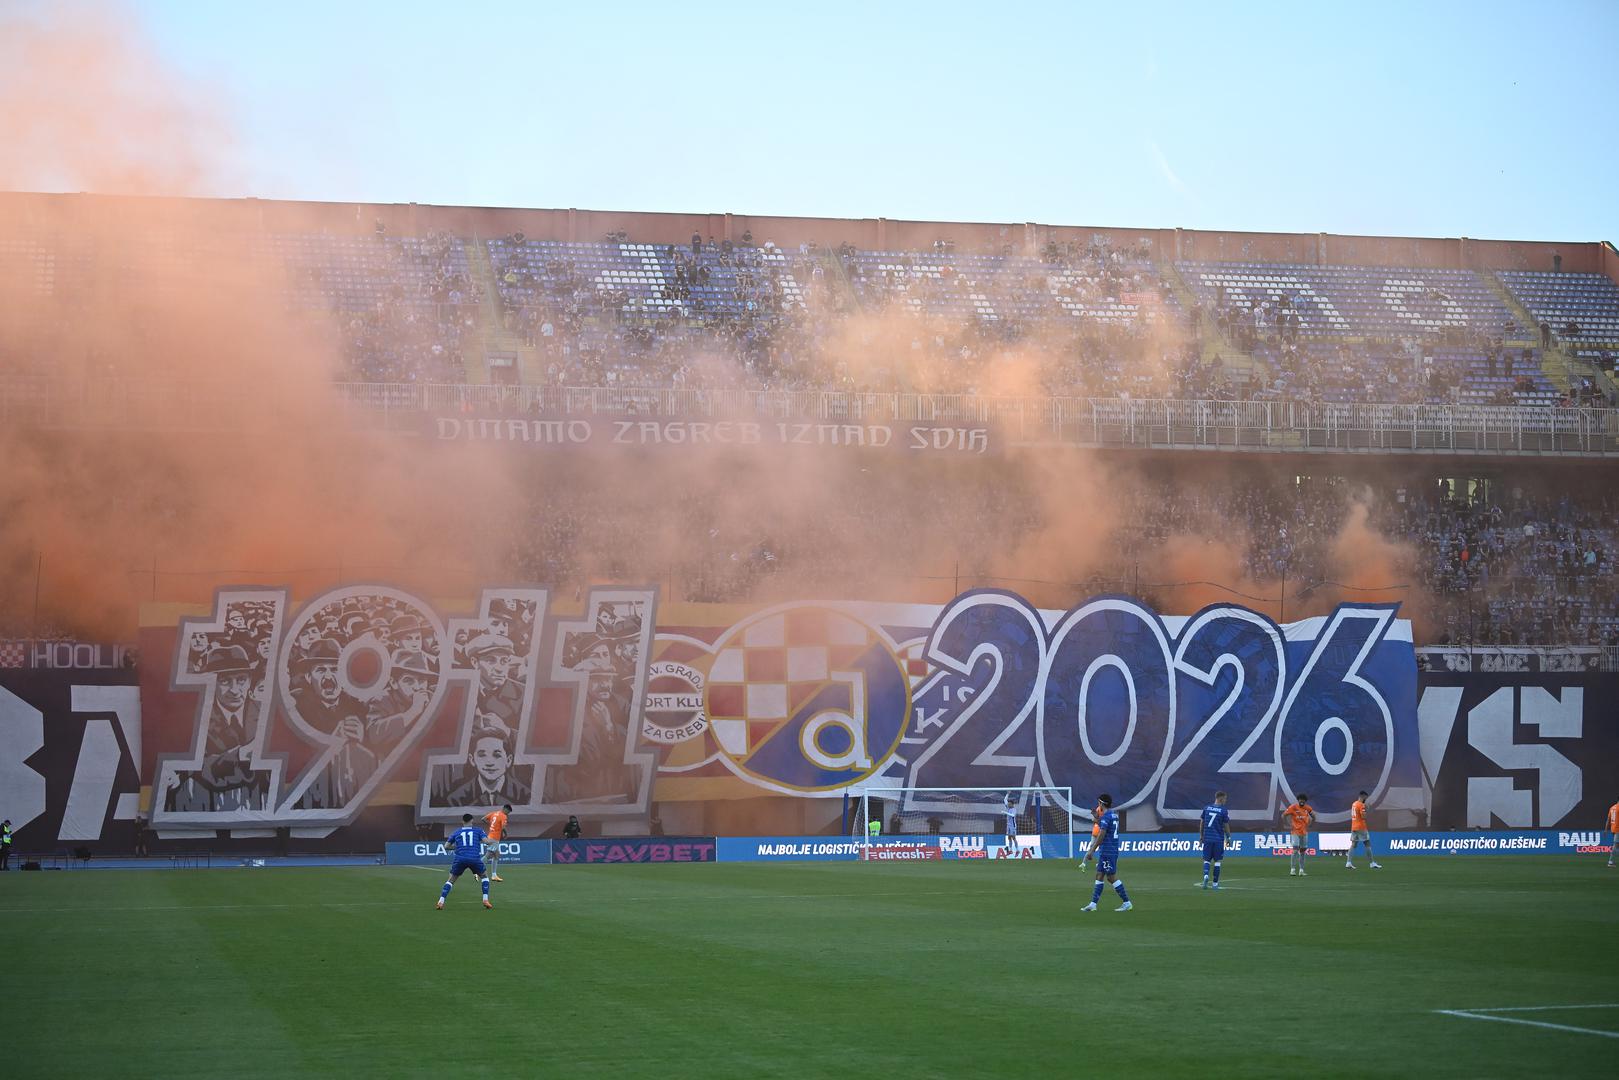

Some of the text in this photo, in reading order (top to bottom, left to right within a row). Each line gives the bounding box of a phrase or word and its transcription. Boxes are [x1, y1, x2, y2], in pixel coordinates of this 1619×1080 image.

[437, 418, 592, 444] DINAMO
[612, 420, 761, 445] ZAGREB
[777, 423, 892, 447] IZNAD
[152, 588, 656, 827] 1911
[900, 589, 1402, 822] 2026
[1208, 812, 1217, 827] 7
[460, 831, 474, 846] 11
[939, 836, 984, 851] RALU
[1132, 838, 1190, 851] LOGISTIČKO
[1390, 837, 1547, 850] NAJBOLJE LOGISTIČKO RJEŠENJE
[1558, 832, 1601, 847] RALU
[585, 844, 714, 862] FAVBET
[758, 844, 811, 855] NAJBOLJE
[878, 849, 925, 859] aircash
